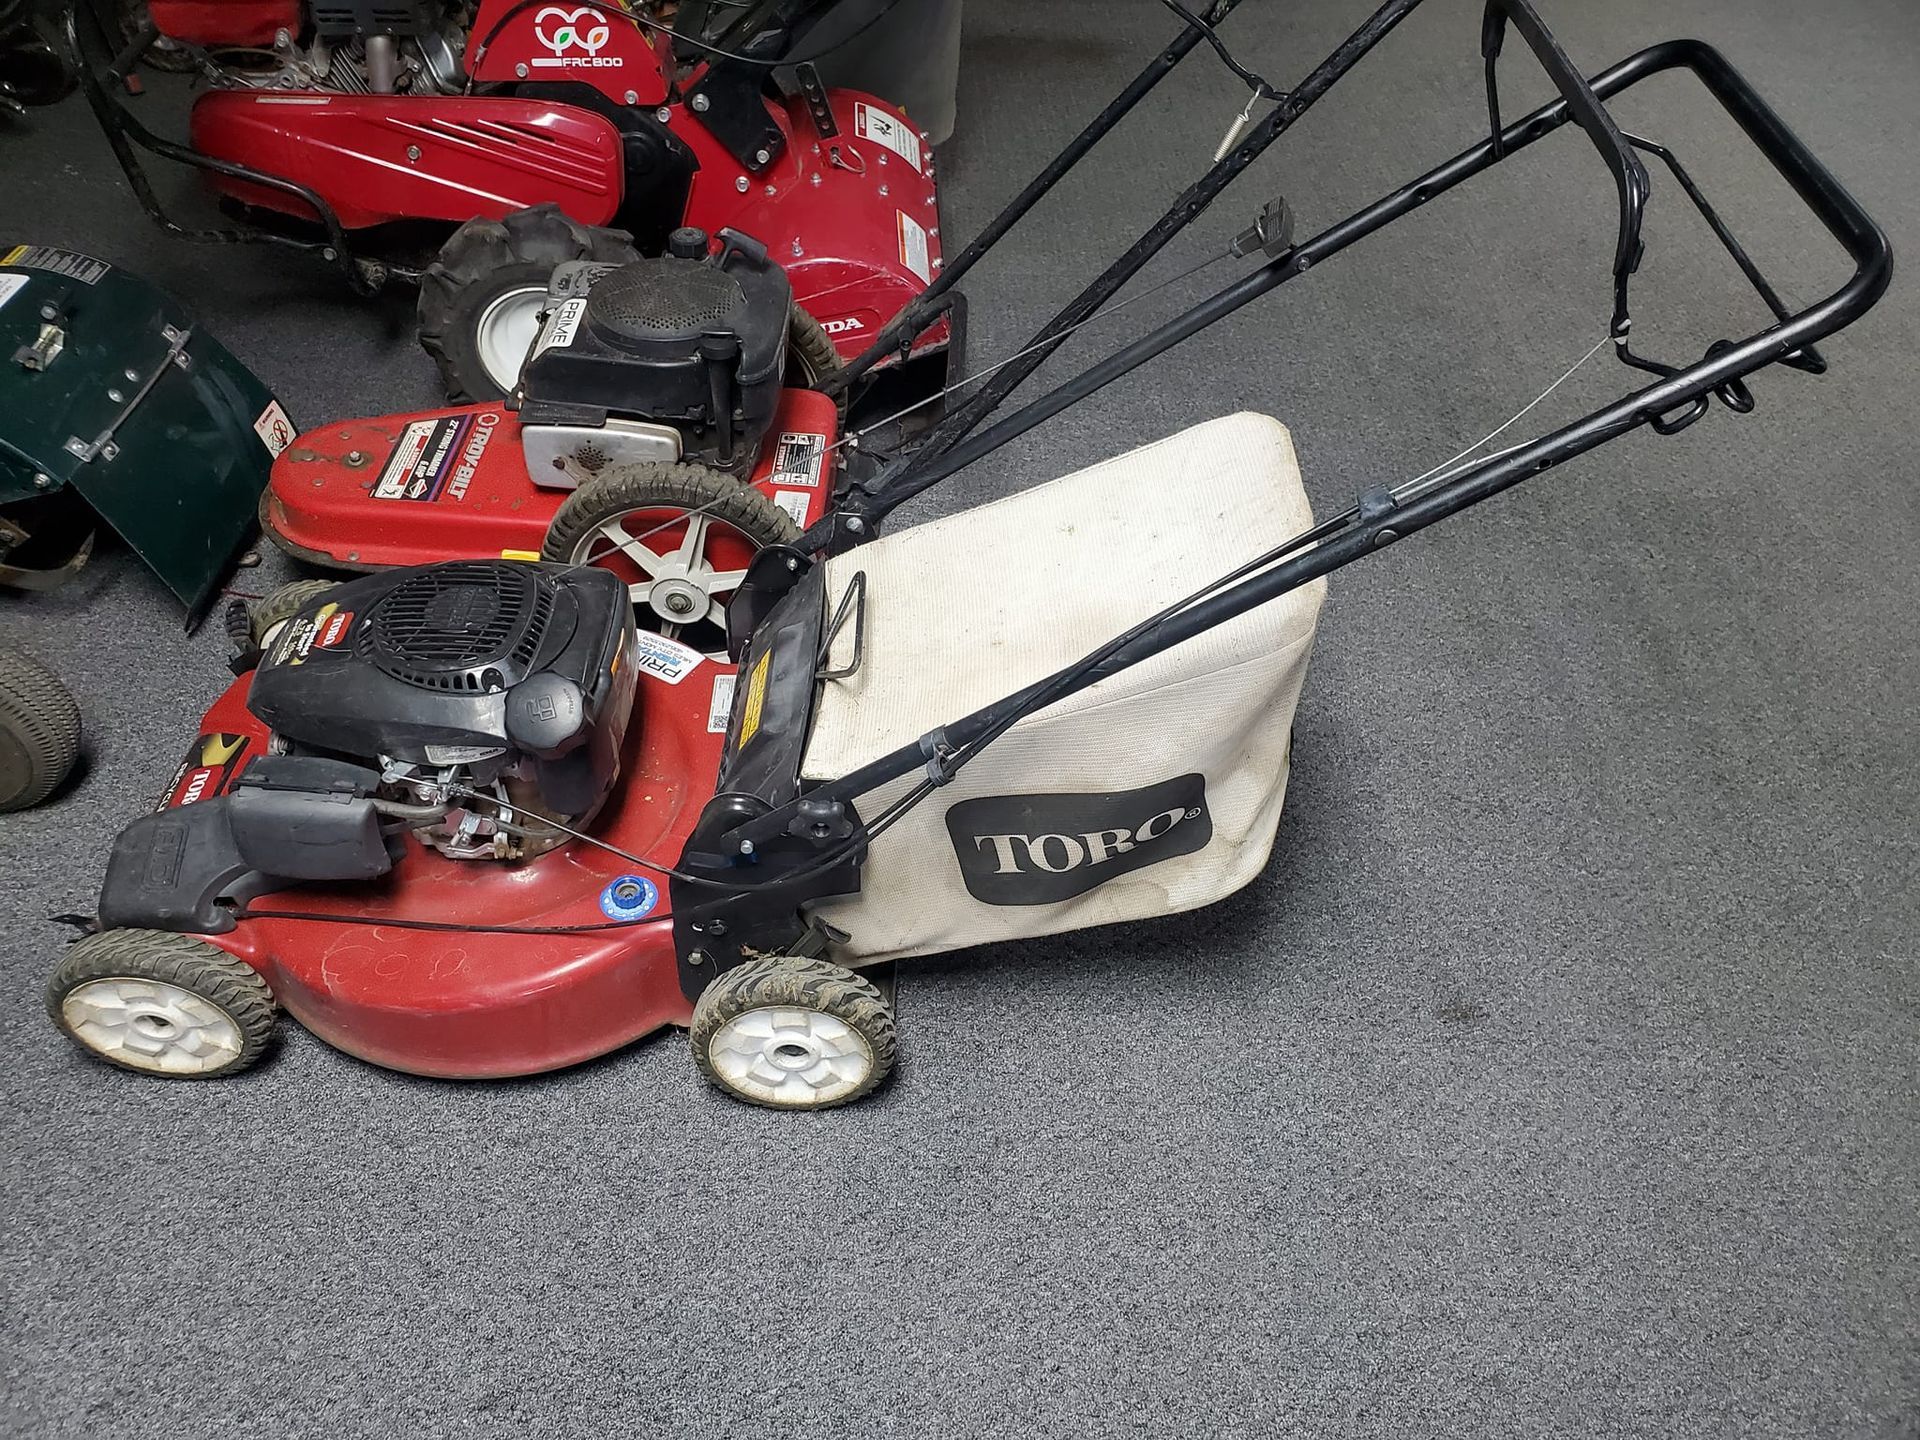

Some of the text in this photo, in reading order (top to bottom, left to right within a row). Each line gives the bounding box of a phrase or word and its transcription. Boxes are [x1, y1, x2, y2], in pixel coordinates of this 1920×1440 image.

[562, 57, 623, 67] FRC800
[552, 302, 579, 343] PRIME
[442, 428, 454, 450] STRING
[426, 449, 446, 477] TRIMMER
[447, 426, 494, 501] TROY-BILT
[324, 614, 345, 646] TORO
